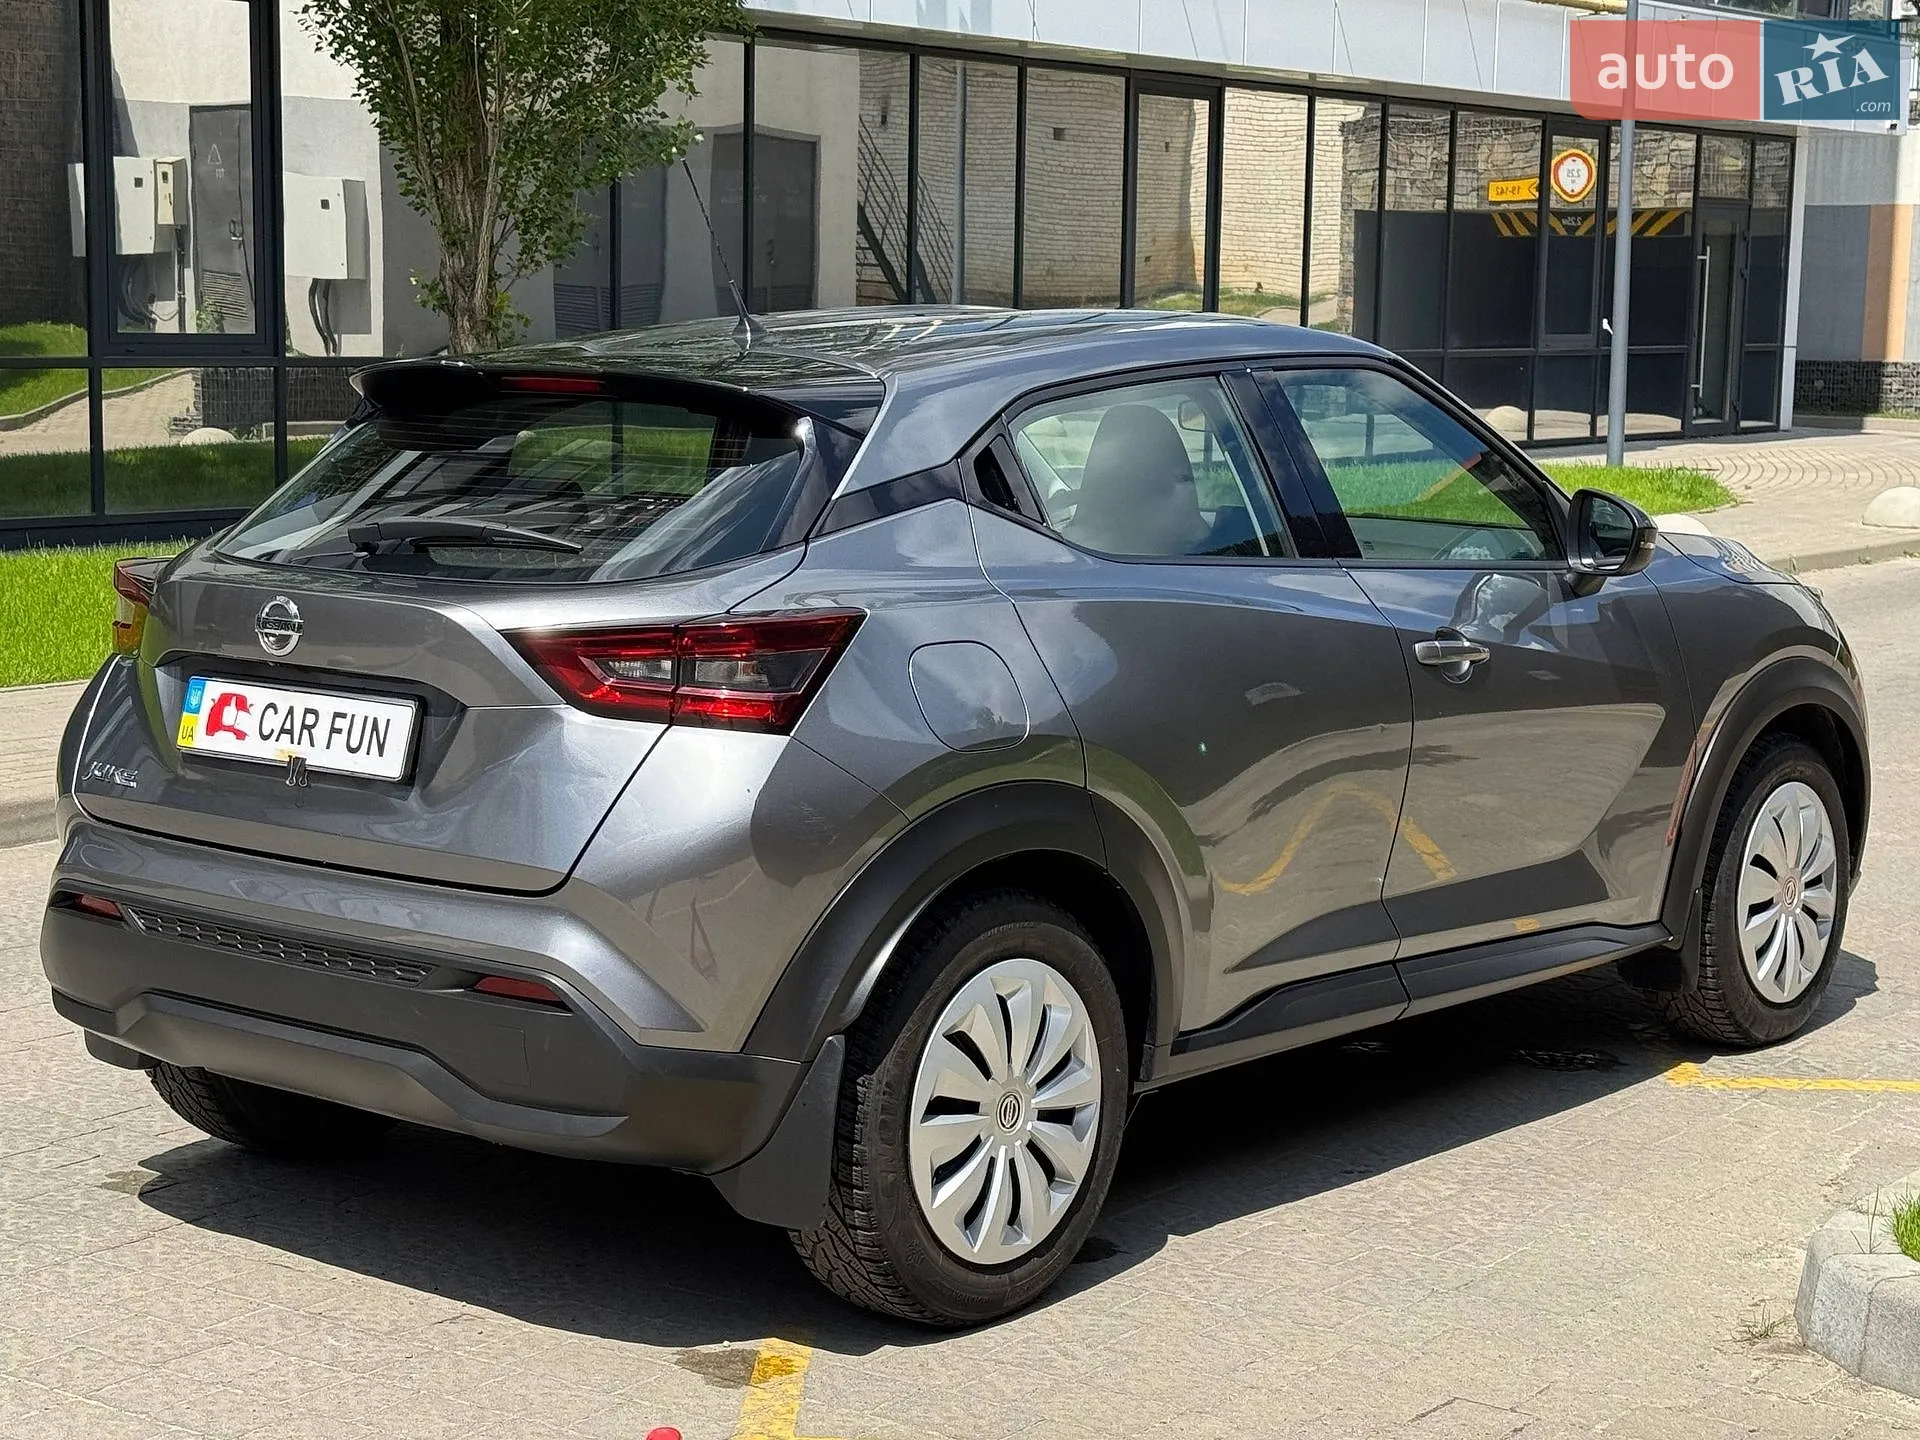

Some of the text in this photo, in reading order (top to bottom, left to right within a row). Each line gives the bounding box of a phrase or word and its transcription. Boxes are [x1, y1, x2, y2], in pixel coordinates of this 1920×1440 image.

[257, 618, 301, 632] NISSAN
[181, 724, 194, 742] UA
[258, 702, 391, 758] CAR FUN
[81, 761, 138, 788] JUKE
